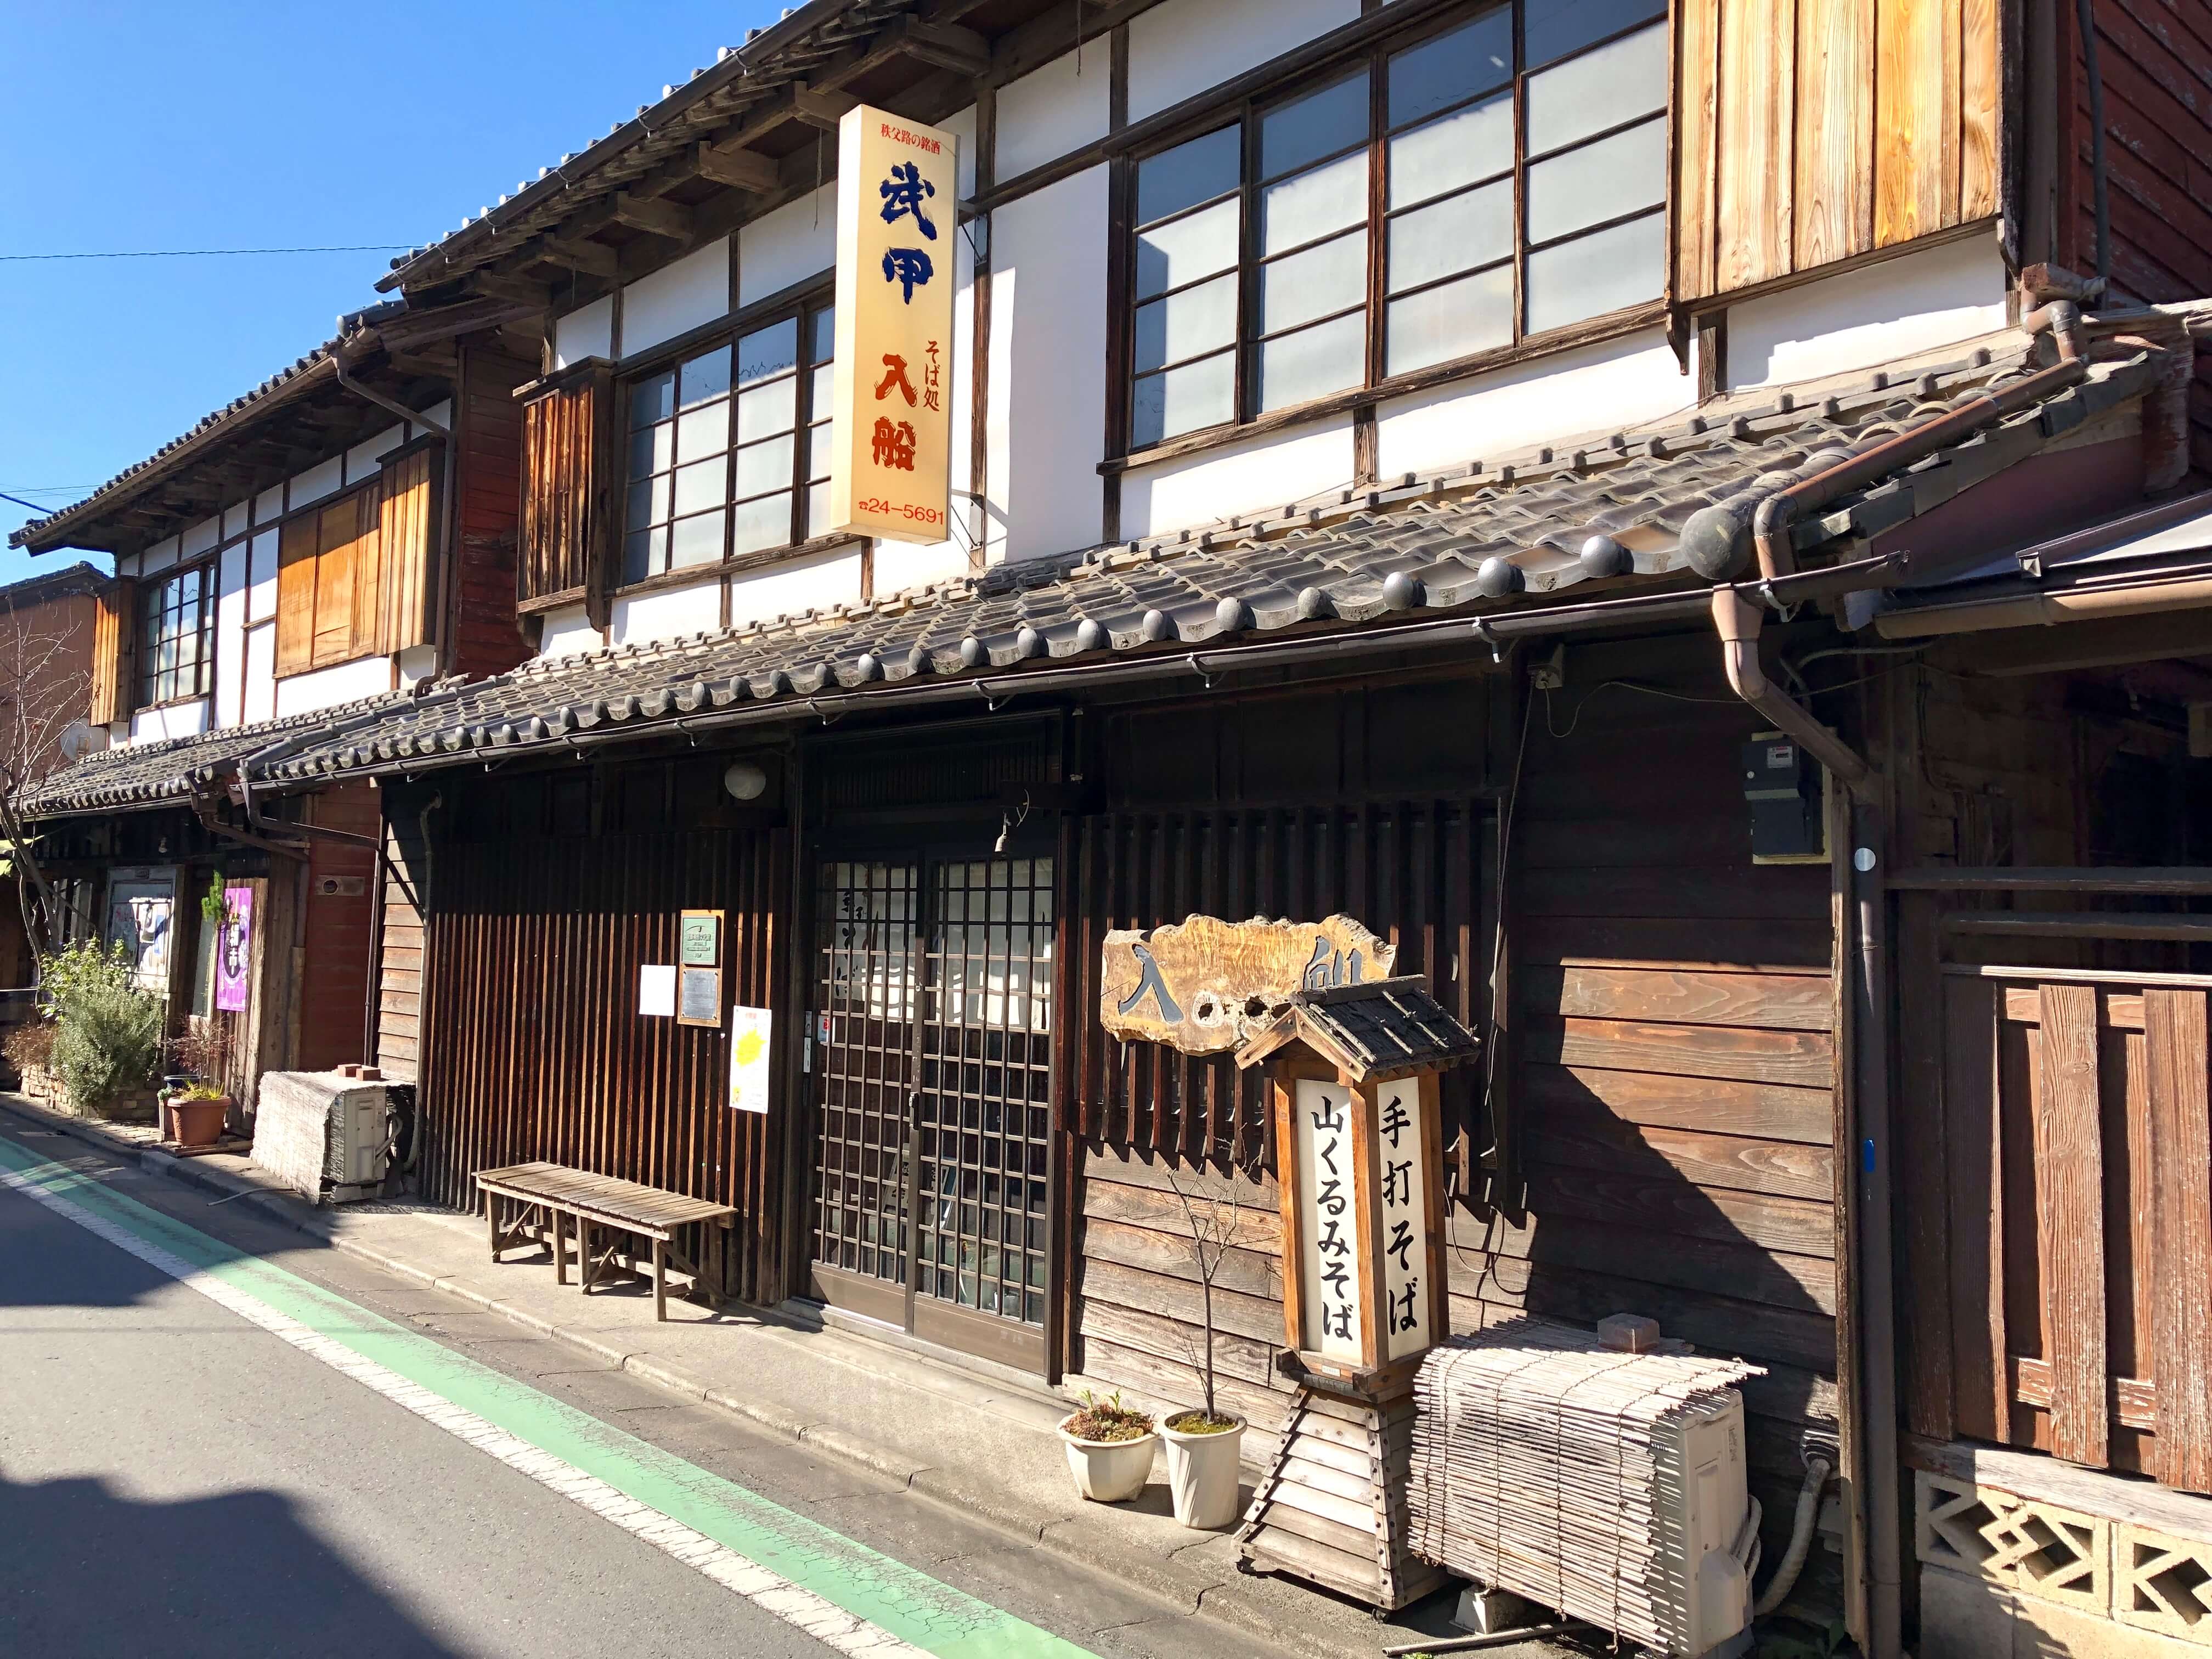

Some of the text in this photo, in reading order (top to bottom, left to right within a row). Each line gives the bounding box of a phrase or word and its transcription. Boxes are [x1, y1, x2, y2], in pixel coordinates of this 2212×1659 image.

[880, 123, 941, 155] 秩父路の銘酒
[879, 161, 938, 305] 武甲
[871, 353, 918, 472] 入船
[923, 340, 941, 412] そば処
[1310, 1096, 1353, 1342] 山くるみそば
[1379, 1095, 1419, 1336] 手打そば
